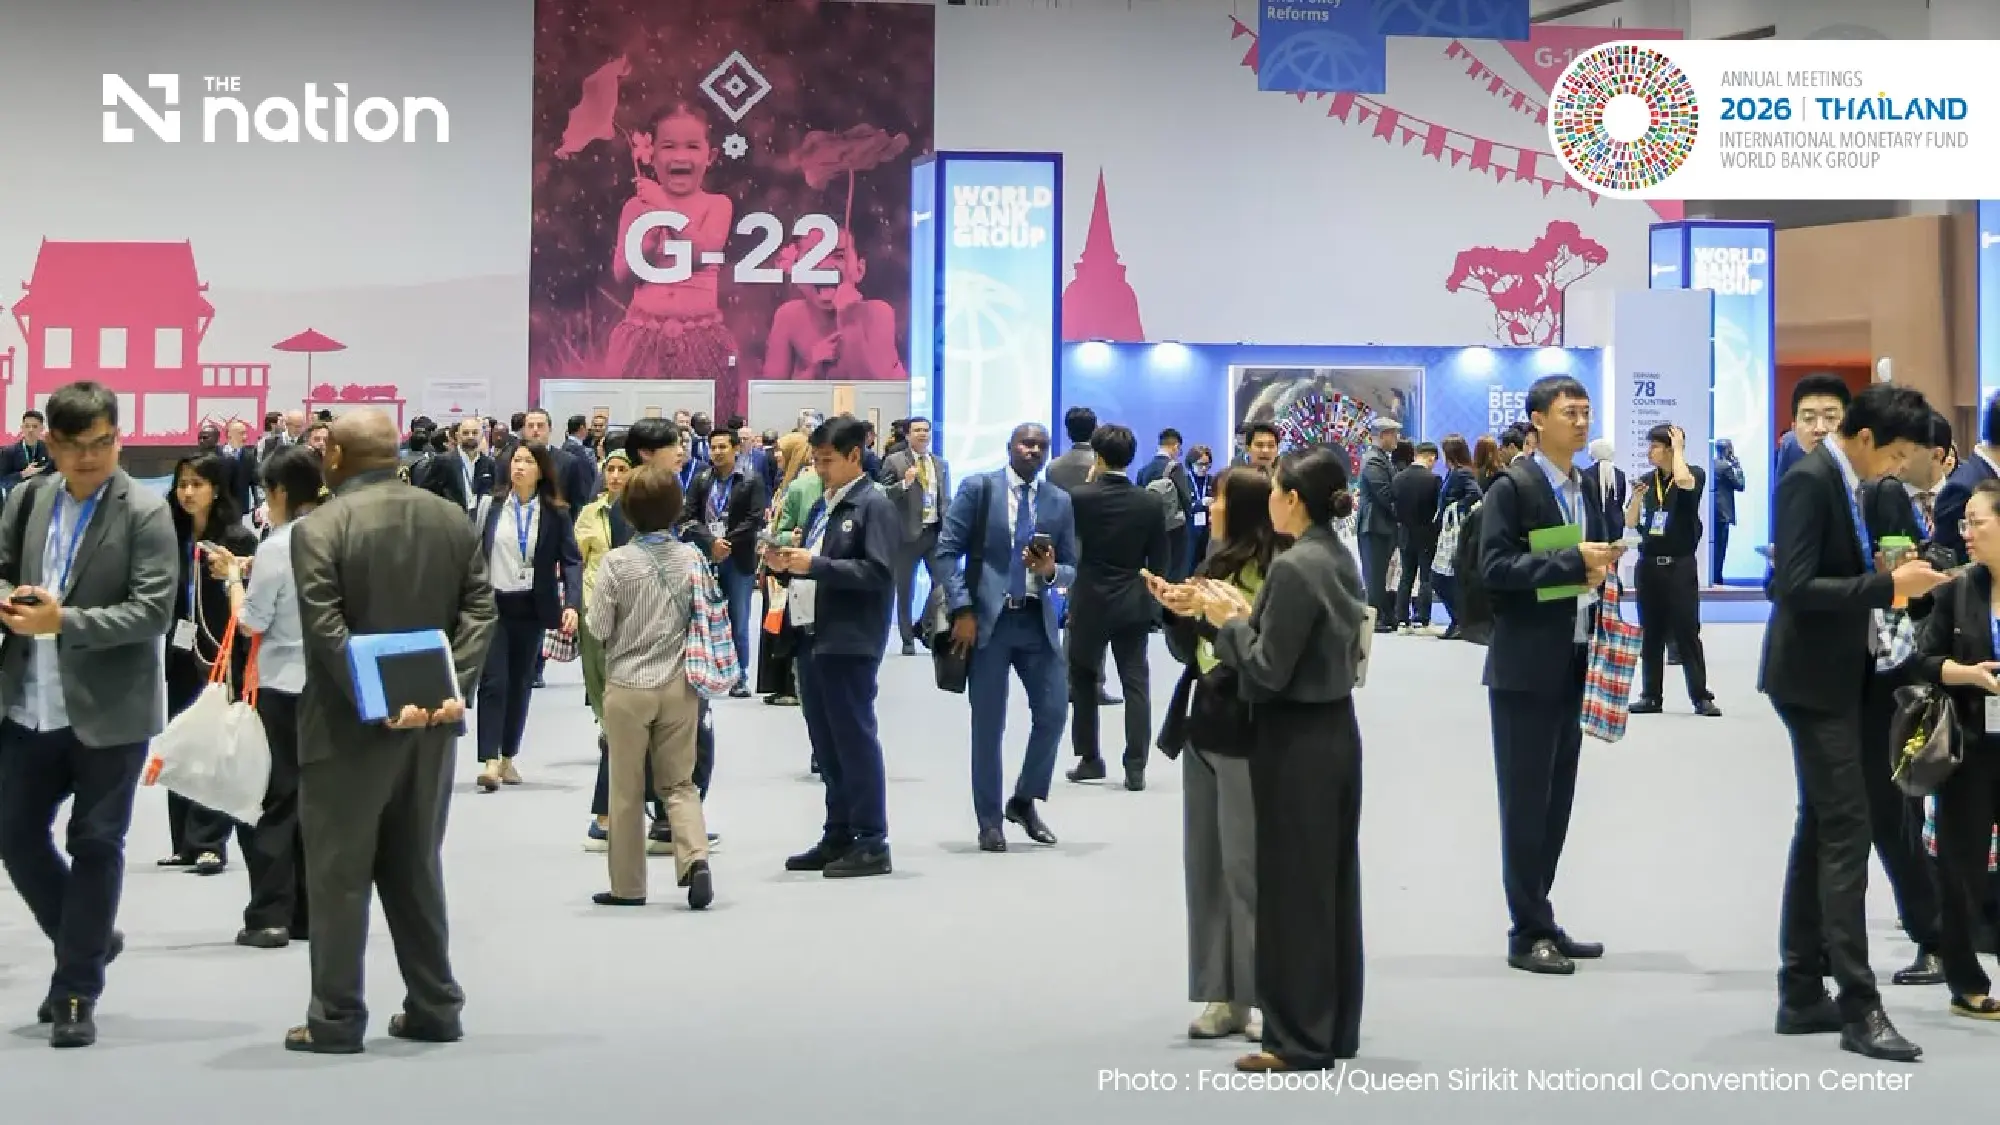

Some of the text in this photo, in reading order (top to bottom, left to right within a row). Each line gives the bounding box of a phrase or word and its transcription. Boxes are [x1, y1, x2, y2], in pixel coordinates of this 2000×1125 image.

[1267, 6, 1329, 22] Reforms
[1534, 46, 1588, 68] G-1
[953, 185, 1052, 207] WORLD
[953, 204, 1030, 227] BANK
[625, 210, 839, 284] G-22
[953, 226, 1046, 248] GROUP
[1694, 247, 1767, 264] WORLD
[1695, 262, 1750, 279] BANK
[1633, 381, 1656, 397] 78
